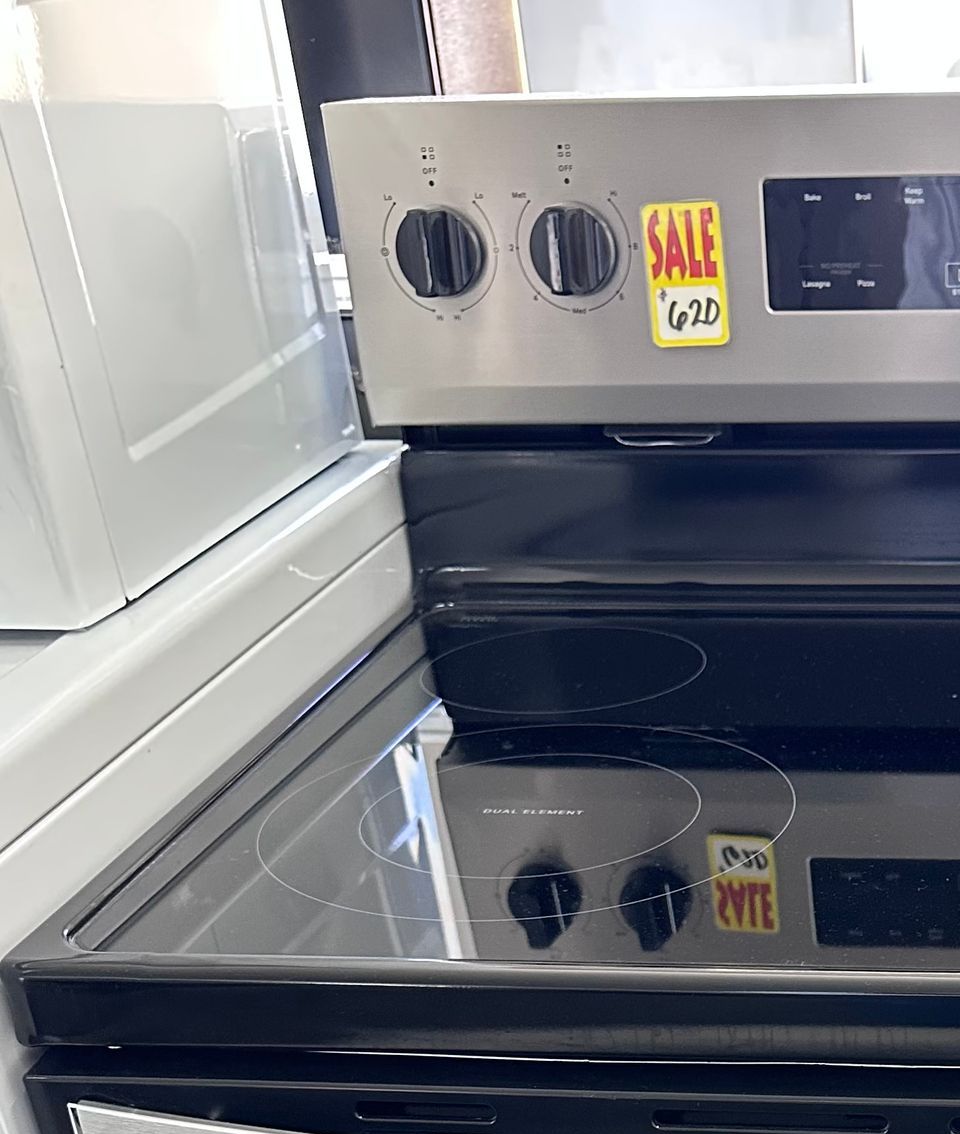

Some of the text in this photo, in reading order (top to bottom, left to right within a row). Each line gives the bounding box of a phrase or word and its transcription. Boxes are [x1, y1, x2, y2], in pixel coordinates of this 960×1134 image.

[422, 167, 438, 175] OFF
[804, 193, 822, 202] Bake
[855, 192, 872, 201] Broil
[647, 207, 718, 280] SALE
